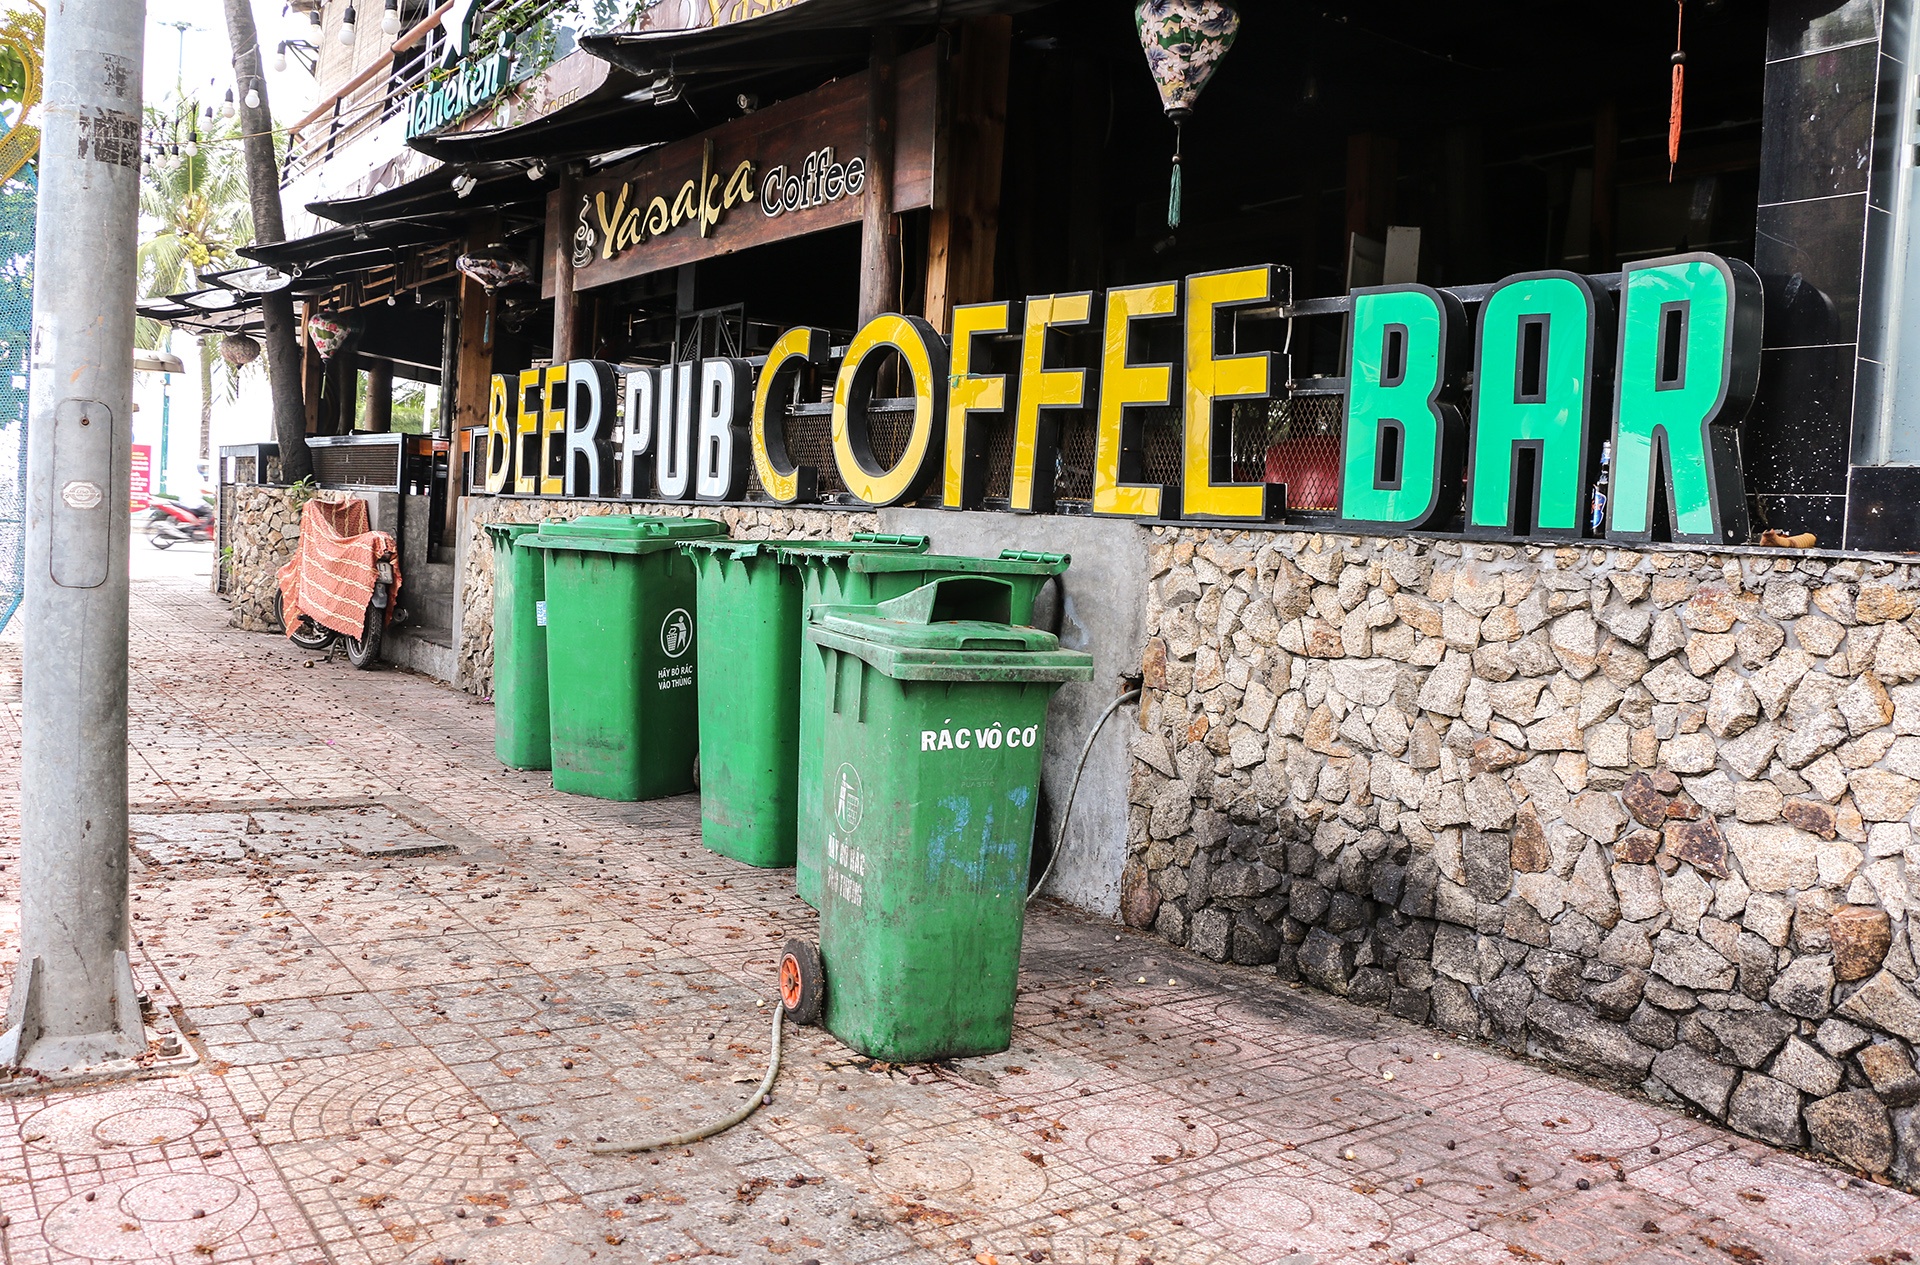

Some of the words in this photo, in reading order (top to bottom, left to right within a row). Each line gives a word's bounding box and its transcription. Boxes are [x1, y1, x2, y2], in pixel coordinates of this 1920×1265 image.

[404, 31, 510, 140] Heineken
[596, 138, 755, 260] Yasaka
[761, 147, 866, 218] Coffee
[485, 360, 608, 498] BEER
[621, 357, 748, 500] PUB
[751, 263, 1288, 523] COFFEE
[1340, 251, 1758, 545] BAR
[921, 718, 971, 752] RÁC
[975, 721, 1003, 749] VÔ
[1006, 724, 1038, 748] CƠ
